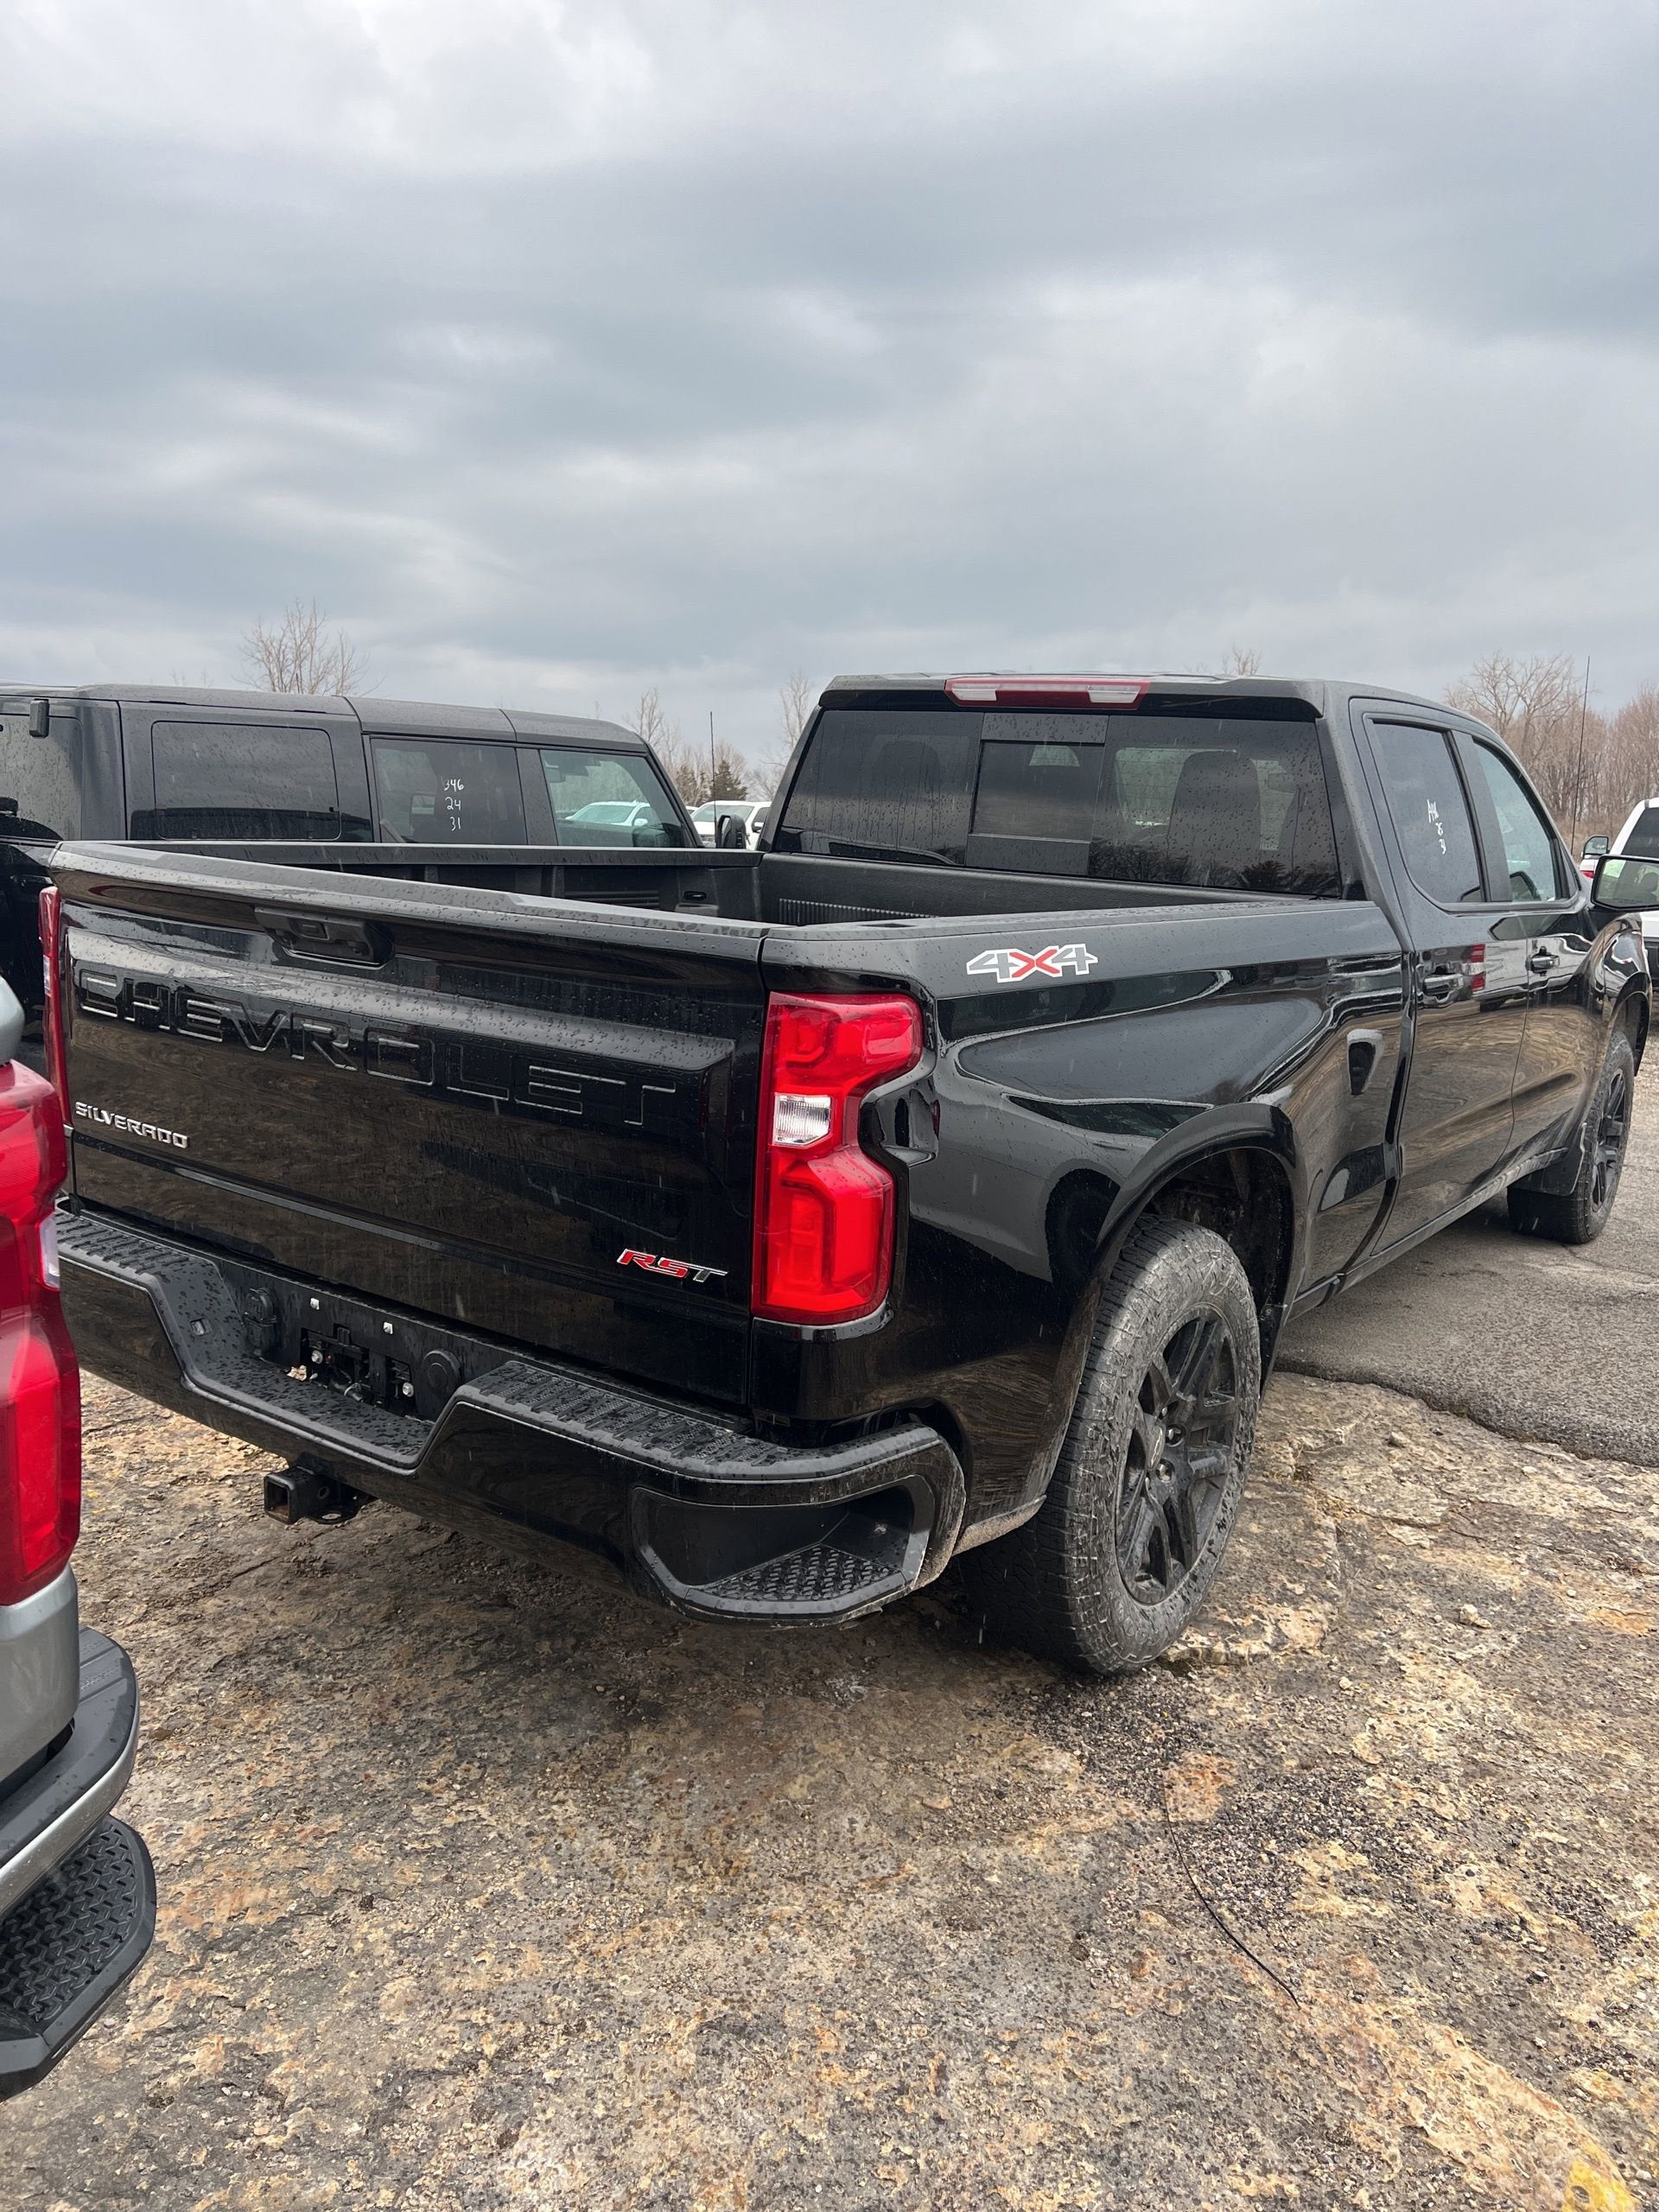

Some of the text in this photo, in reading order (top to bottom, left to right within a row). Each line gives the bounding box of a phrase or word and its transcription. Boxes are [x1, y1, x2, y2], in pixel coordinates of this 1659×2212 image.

[443, 779, 465, 792] 346
[444, 796, 461, 811] 24
[449, 816, 461, 831] 31
[79, 967, 677, 1125] CHEVROLET
[75, 1102, 188, 1149] SILVERADO
[616, 1248, 729, 1283] RST
